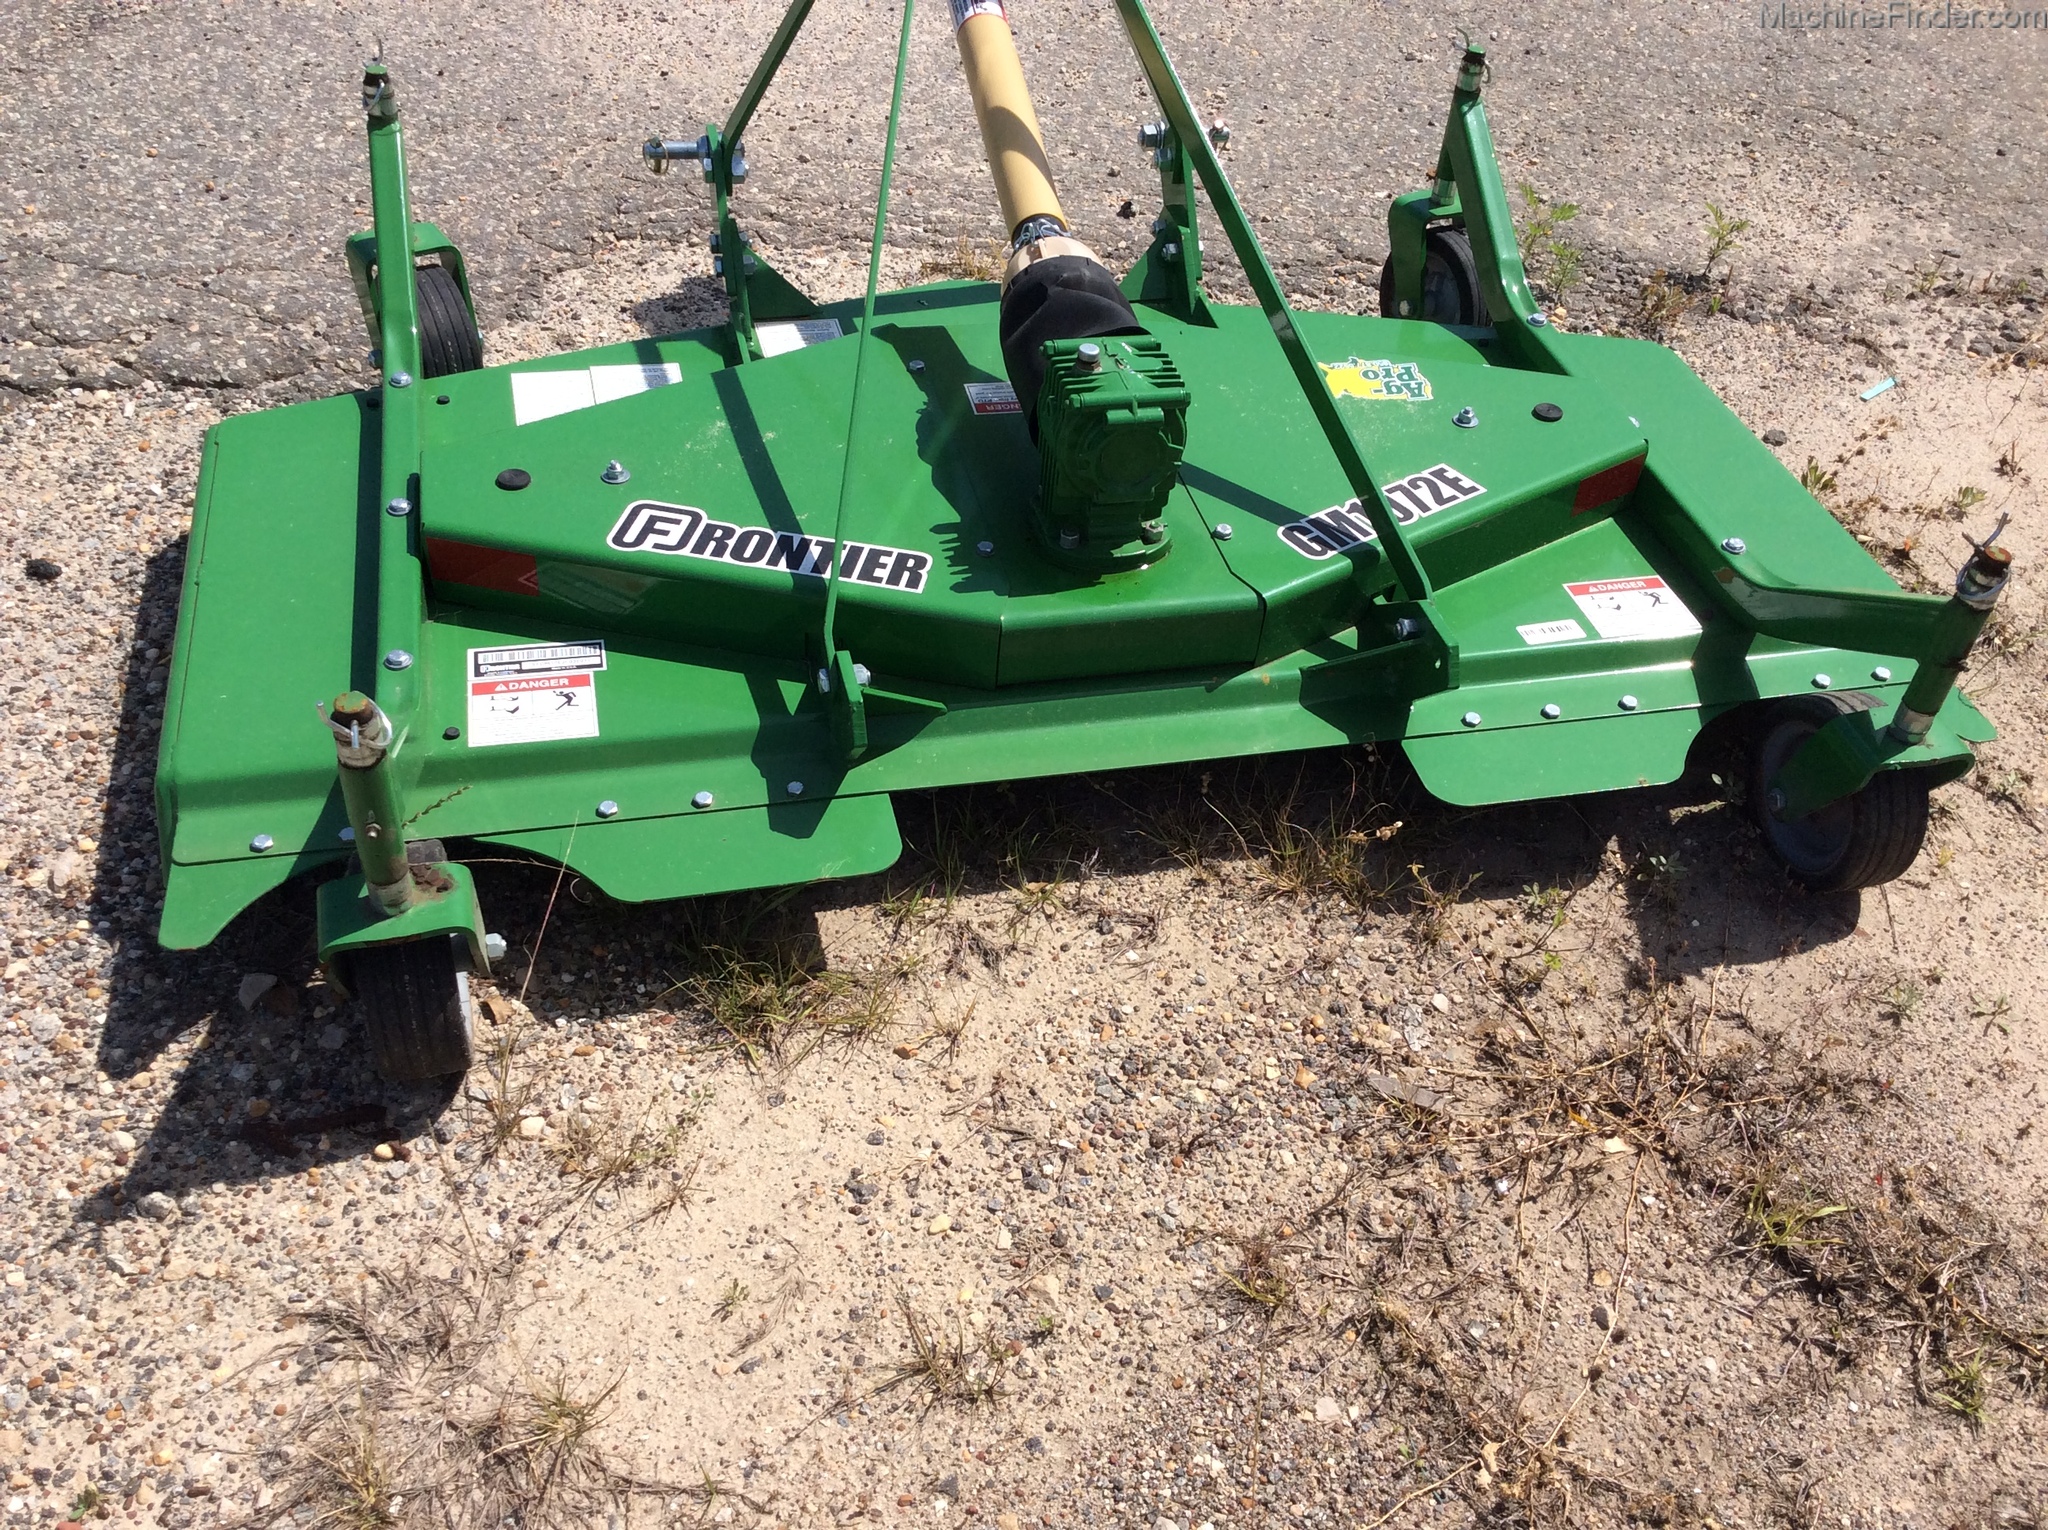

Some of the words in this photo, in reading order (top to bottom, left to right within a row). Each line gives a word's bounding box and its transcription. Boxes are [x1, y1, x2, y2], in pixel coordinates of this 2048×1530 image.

[1361, 366, 1418, 382] Pro
[1373, 381, 1426, 398] Ag-
[610, 502, 929, 590] FRONTIER
[1597, 581, 1647, 591] DANGER
[509, 678, 569, 690] DANGER
